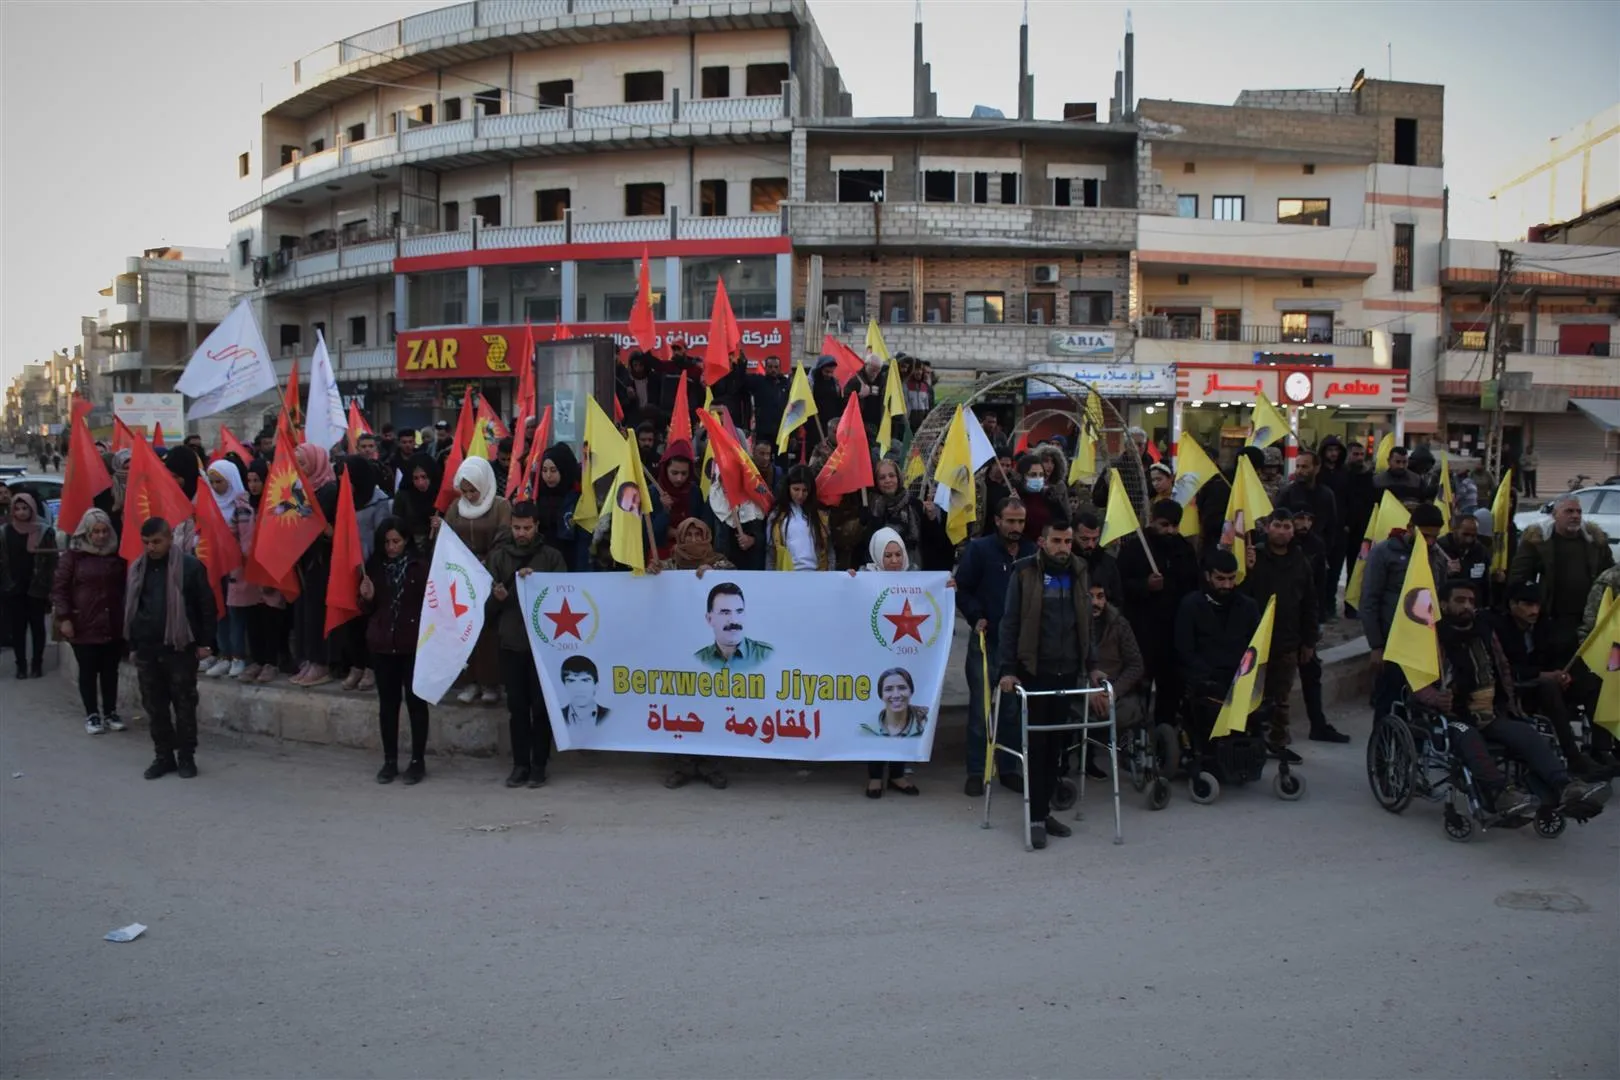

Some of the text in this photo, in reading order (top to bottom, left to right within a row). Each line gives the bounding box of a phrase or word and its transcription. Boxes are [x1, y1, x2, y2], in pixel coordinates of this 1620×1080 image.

[742, 327, 782, 348] شركة
[1066, 336, 1105, 346] ARIA
[405, 338, 458, 370] ZAR
[1325, 380, 1381, 398] مطعم
[556, 584, 575, 593] PYD
[890, 583, 922, 595] ciwan
[557, 642, 579, 651] 2003
[895, 646, 919, 655] 2003
[612, 665, 872, 705] Berxwedan Jiyane
[647, 704, 820, 743] المقاومة حياة
